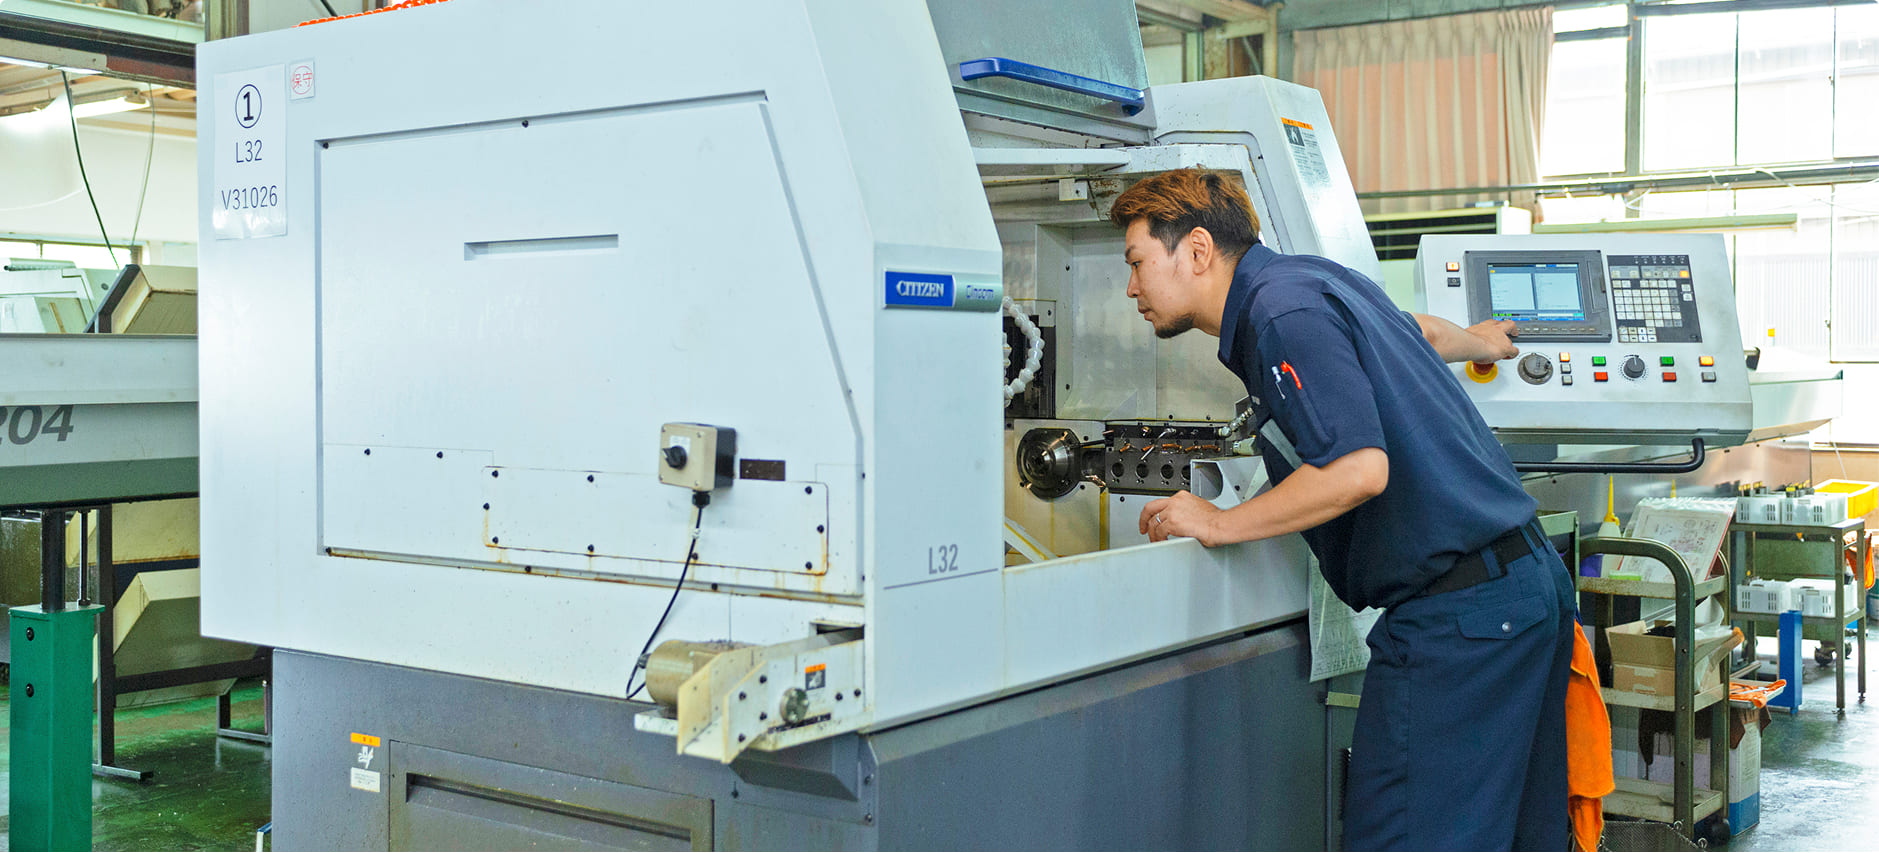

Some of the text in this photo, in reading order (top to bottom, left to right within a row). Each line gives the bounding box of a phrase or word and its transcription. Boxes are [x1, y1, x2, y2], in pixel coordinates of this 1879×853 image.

[235, 140, 262, 163] L32
[221, 185, 278, 210] V31026
[896, 280, 944, 297] CITIZEN
[0, 404, 74, 445] 04
[928, 544, 958, 574] L32
